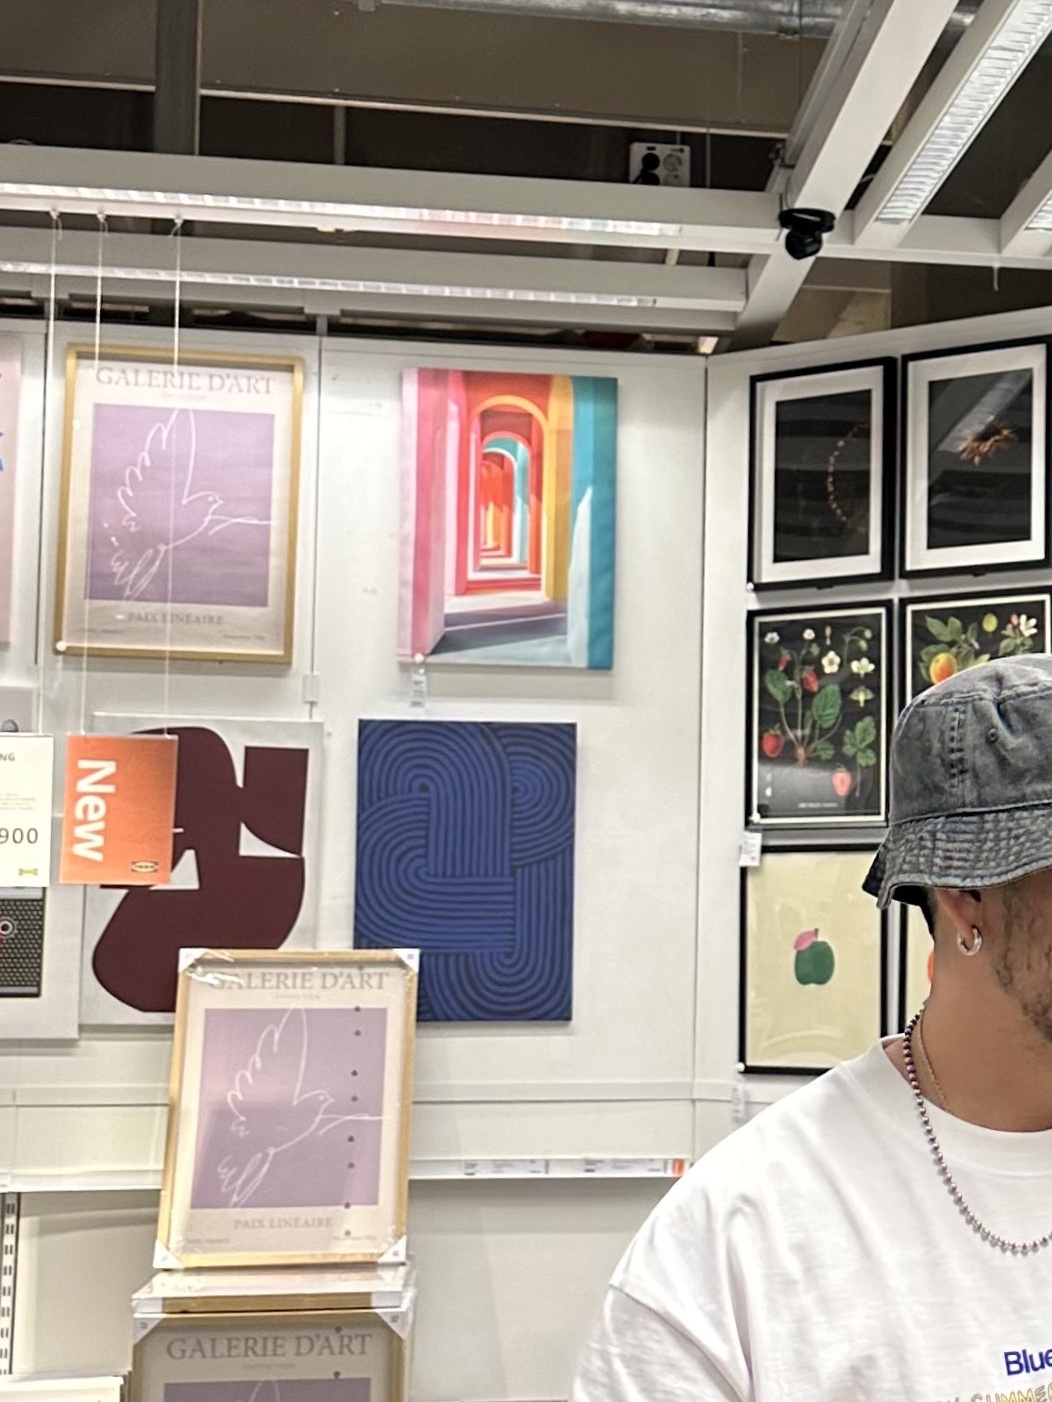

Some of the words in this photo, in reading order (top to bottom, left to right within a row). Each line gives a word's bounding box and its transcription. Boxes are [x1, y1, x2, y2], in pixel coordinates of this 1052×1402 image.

[95, 366, 201, 391] GALERIE
[208, 373, 273, 395] D'ART
[127, 611, 159, 624] PAIX
[72, 759, 117, 863] New
[321, 971, 389, 991] D'ART
[234, 1217, 265, 1230] PAIX
[166, 1336, 287, 1361] GALERIE
[295, 1332, 373, 1357] D'ART
